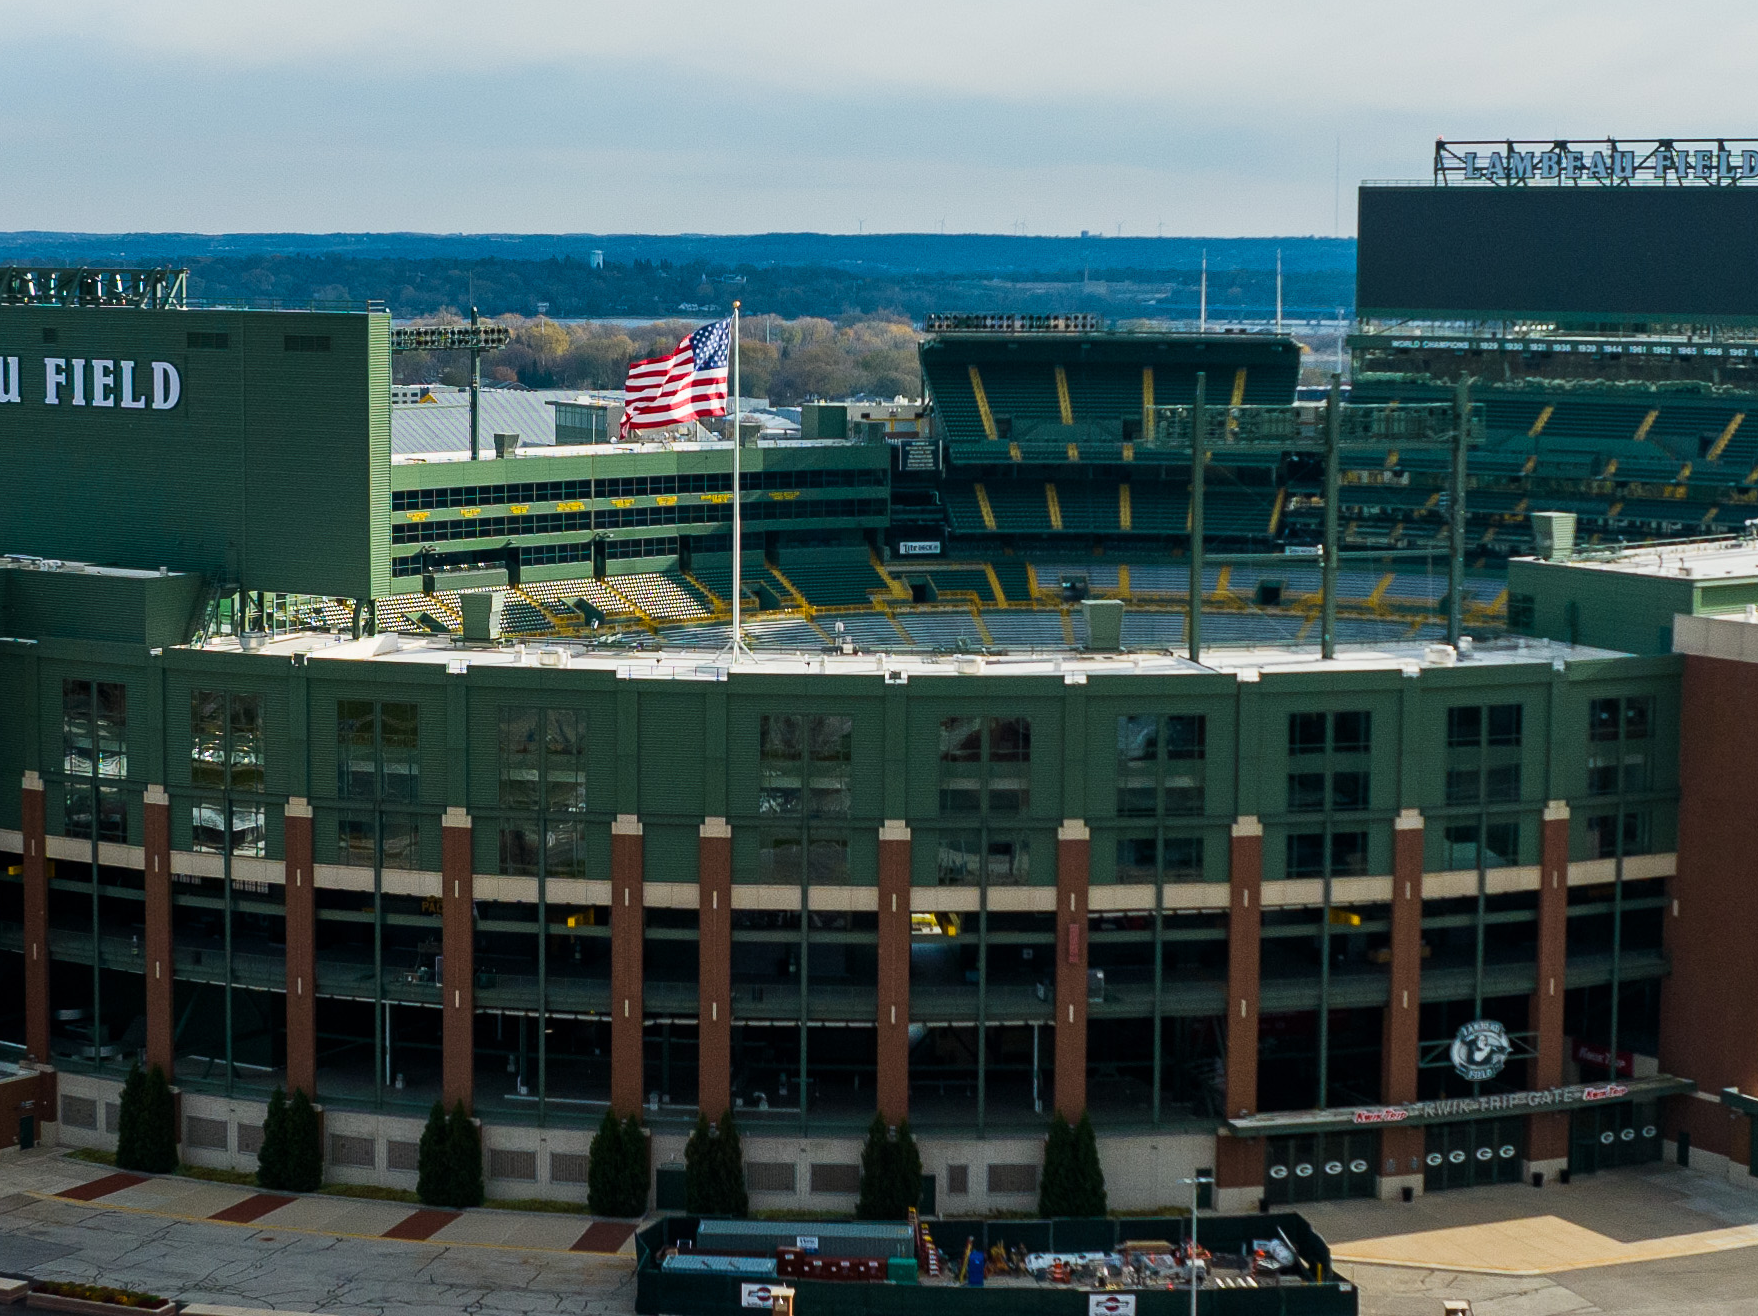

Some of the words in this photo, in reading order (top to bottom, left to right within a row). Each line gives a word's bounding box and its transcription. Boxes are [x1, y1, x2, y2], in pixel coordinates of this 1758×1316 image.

[1464, 149, 1635, 180] LAMBEAU
[44, 357, 181, 410] FIELD
[1527, 1088, 1575, 1107] GATE
